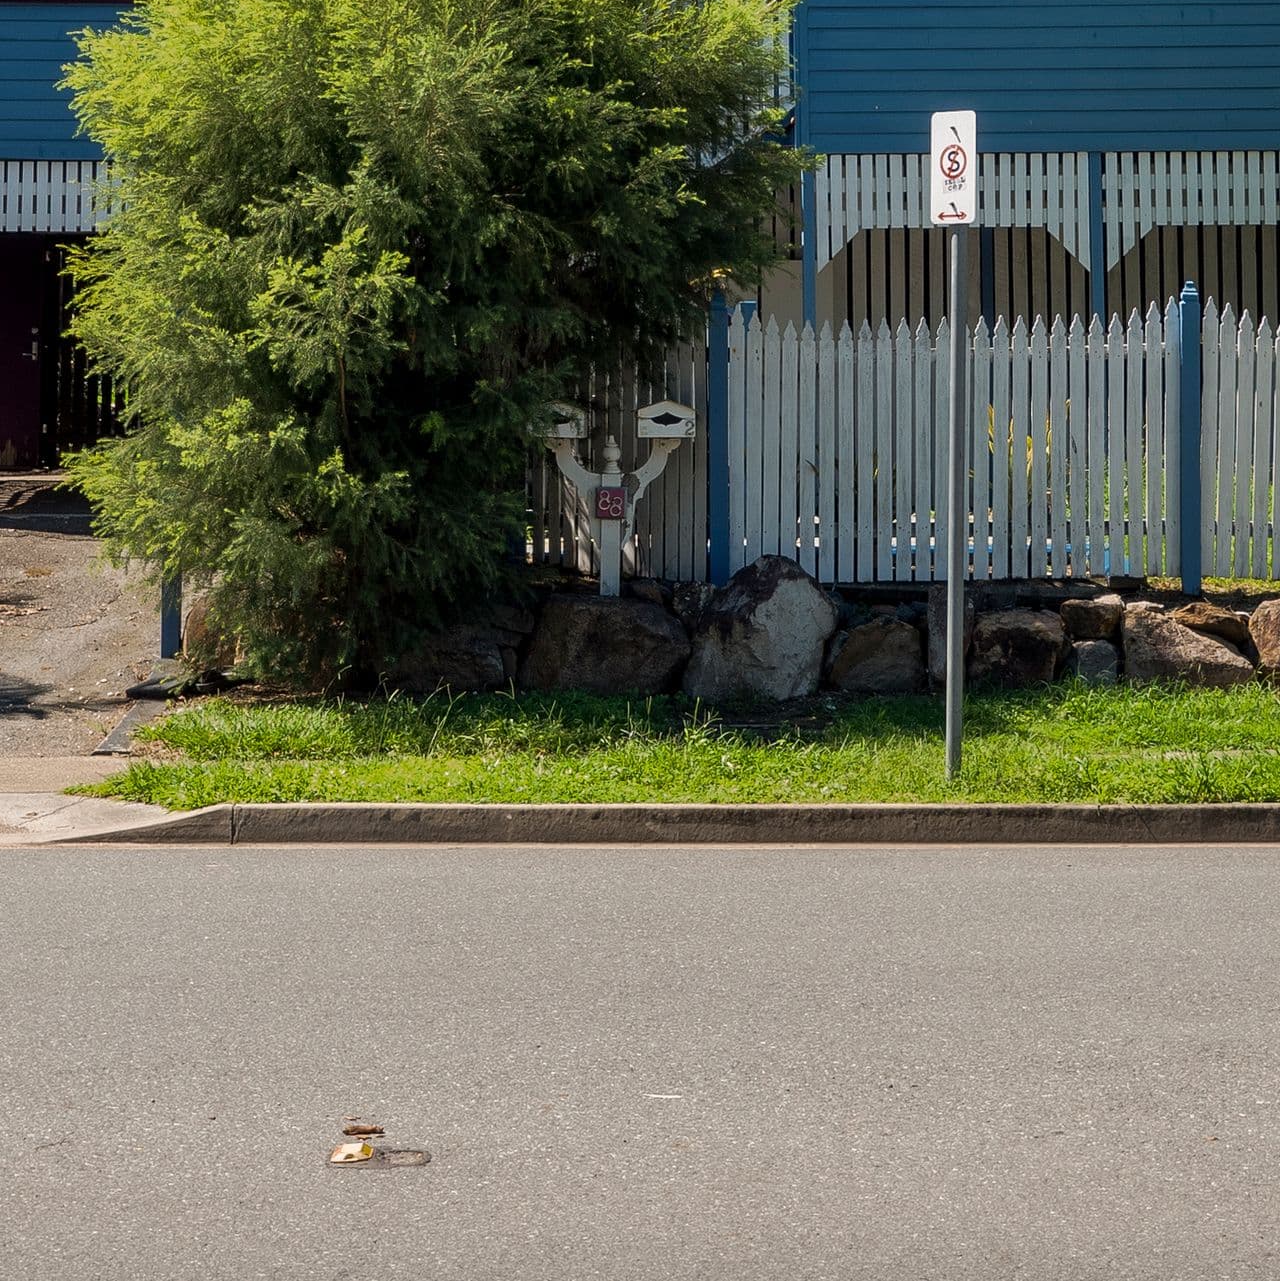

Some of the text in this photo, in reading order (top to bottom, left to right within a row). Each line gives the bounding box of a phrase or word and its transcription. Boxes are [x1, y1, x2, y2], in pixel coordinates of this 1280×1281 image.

[947, 150, 960, 172] S
[685, 420, 695, 436] 2
[599, 490, 623, 517] 88
